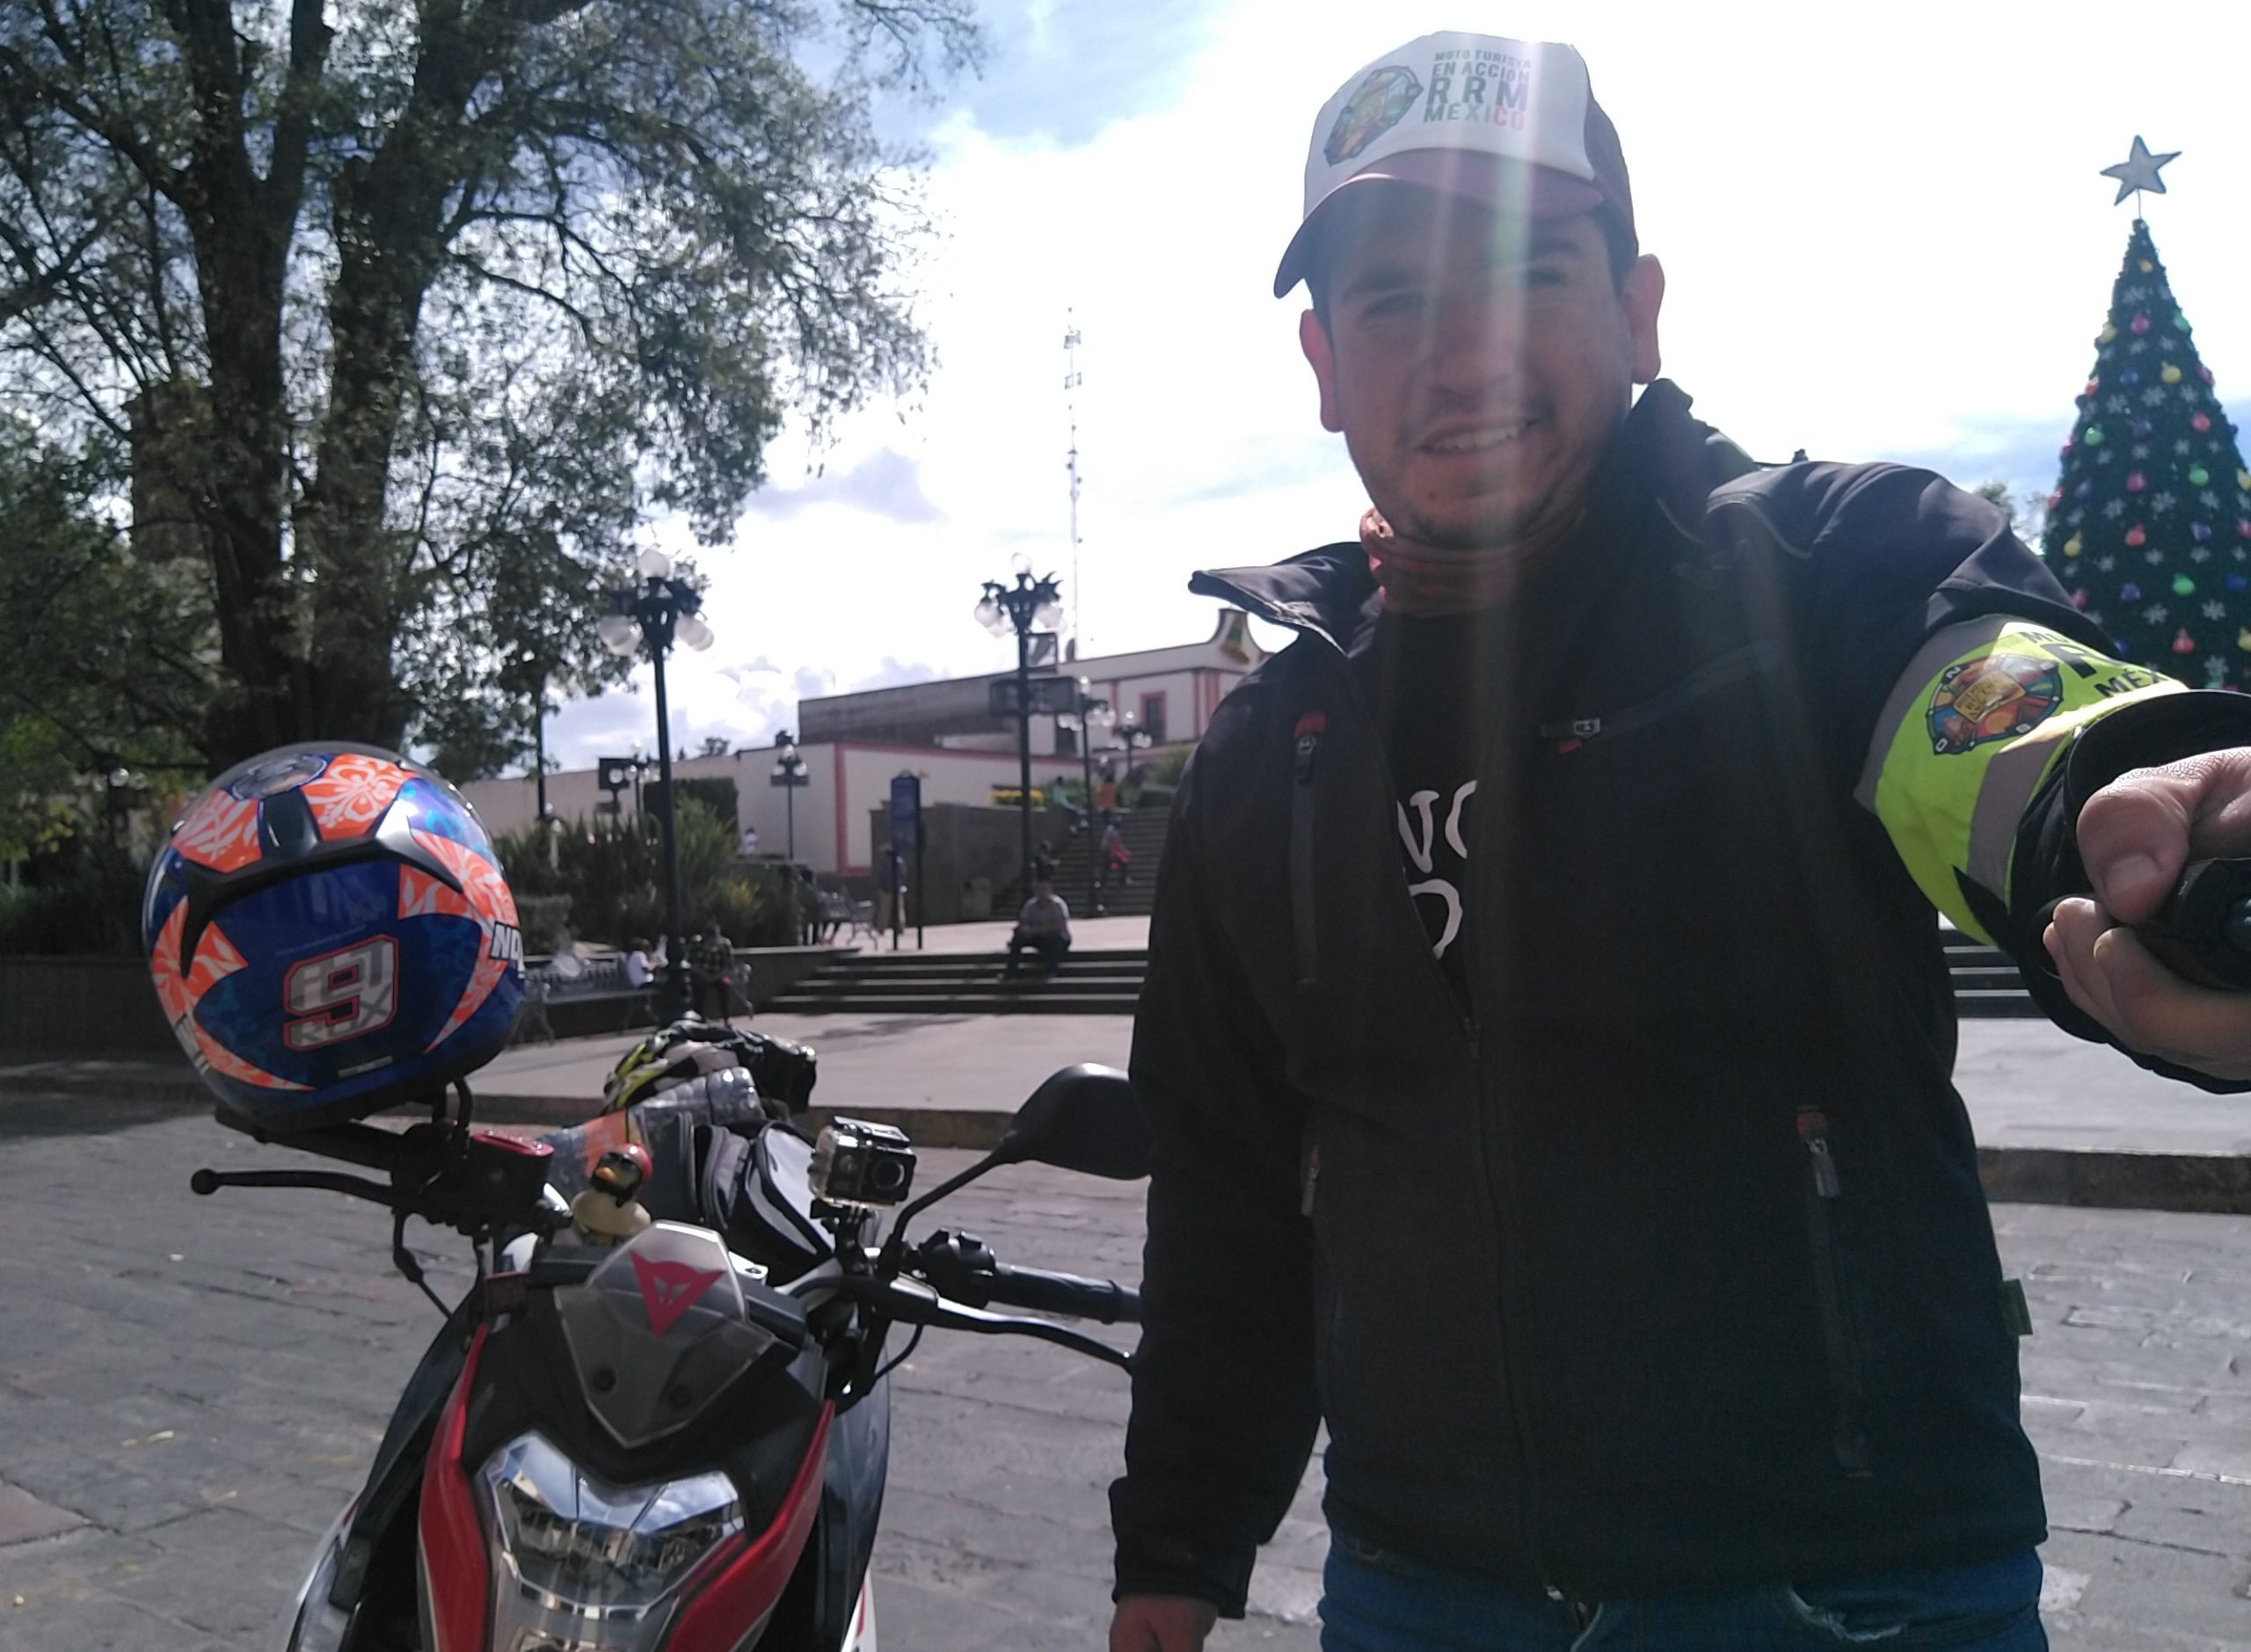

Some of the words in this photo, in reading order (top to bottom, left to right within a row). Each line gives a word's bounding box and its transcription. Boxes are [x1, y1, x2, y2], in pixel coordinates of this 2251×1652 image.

[1434, 49, 1470, 62] MOTO
[1431, 62, 1456, 77] EN
[283, 934, 399, 1052] 9
